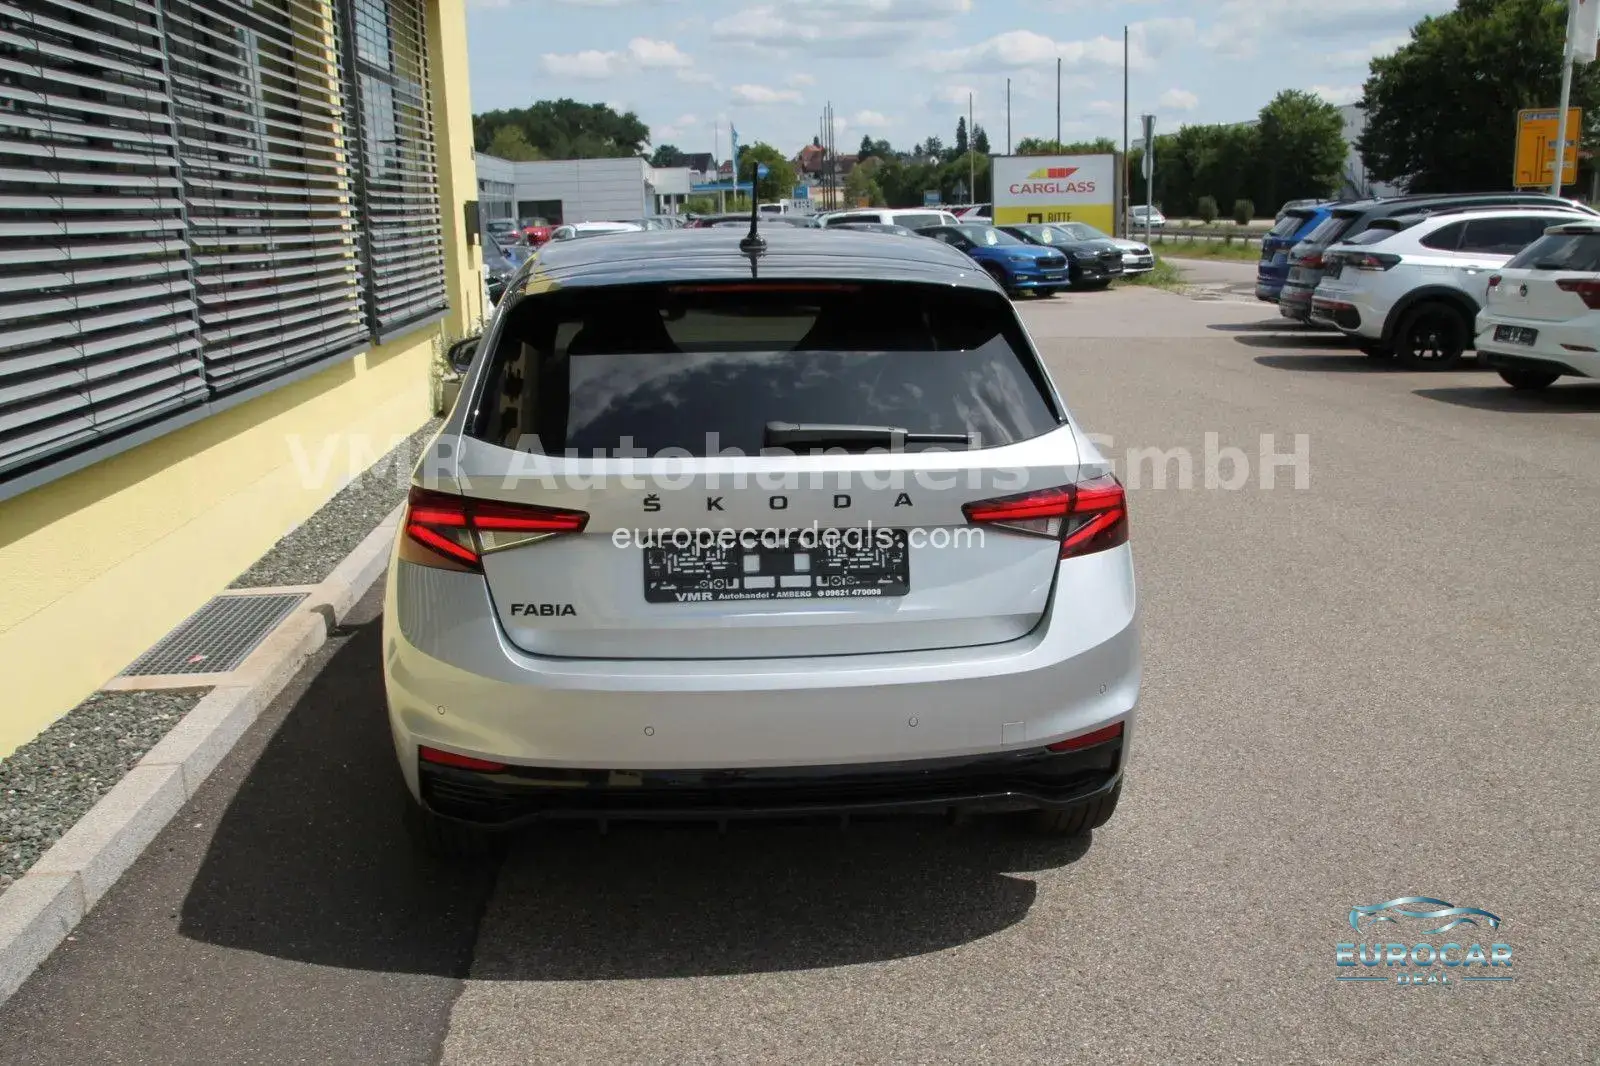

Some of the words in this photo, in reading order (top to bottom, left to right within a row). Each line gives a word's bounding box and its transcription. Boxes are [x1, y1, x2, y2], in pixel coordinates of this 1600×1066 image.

[1009, 181, 1096, 195] CARGLASS
[674, 591, 714, 602] VMR
[718, 591, 770, 600] Autohandel
[776, 590, 812, 598] AMBERG
[510, 603, 578, 617] FABIA
